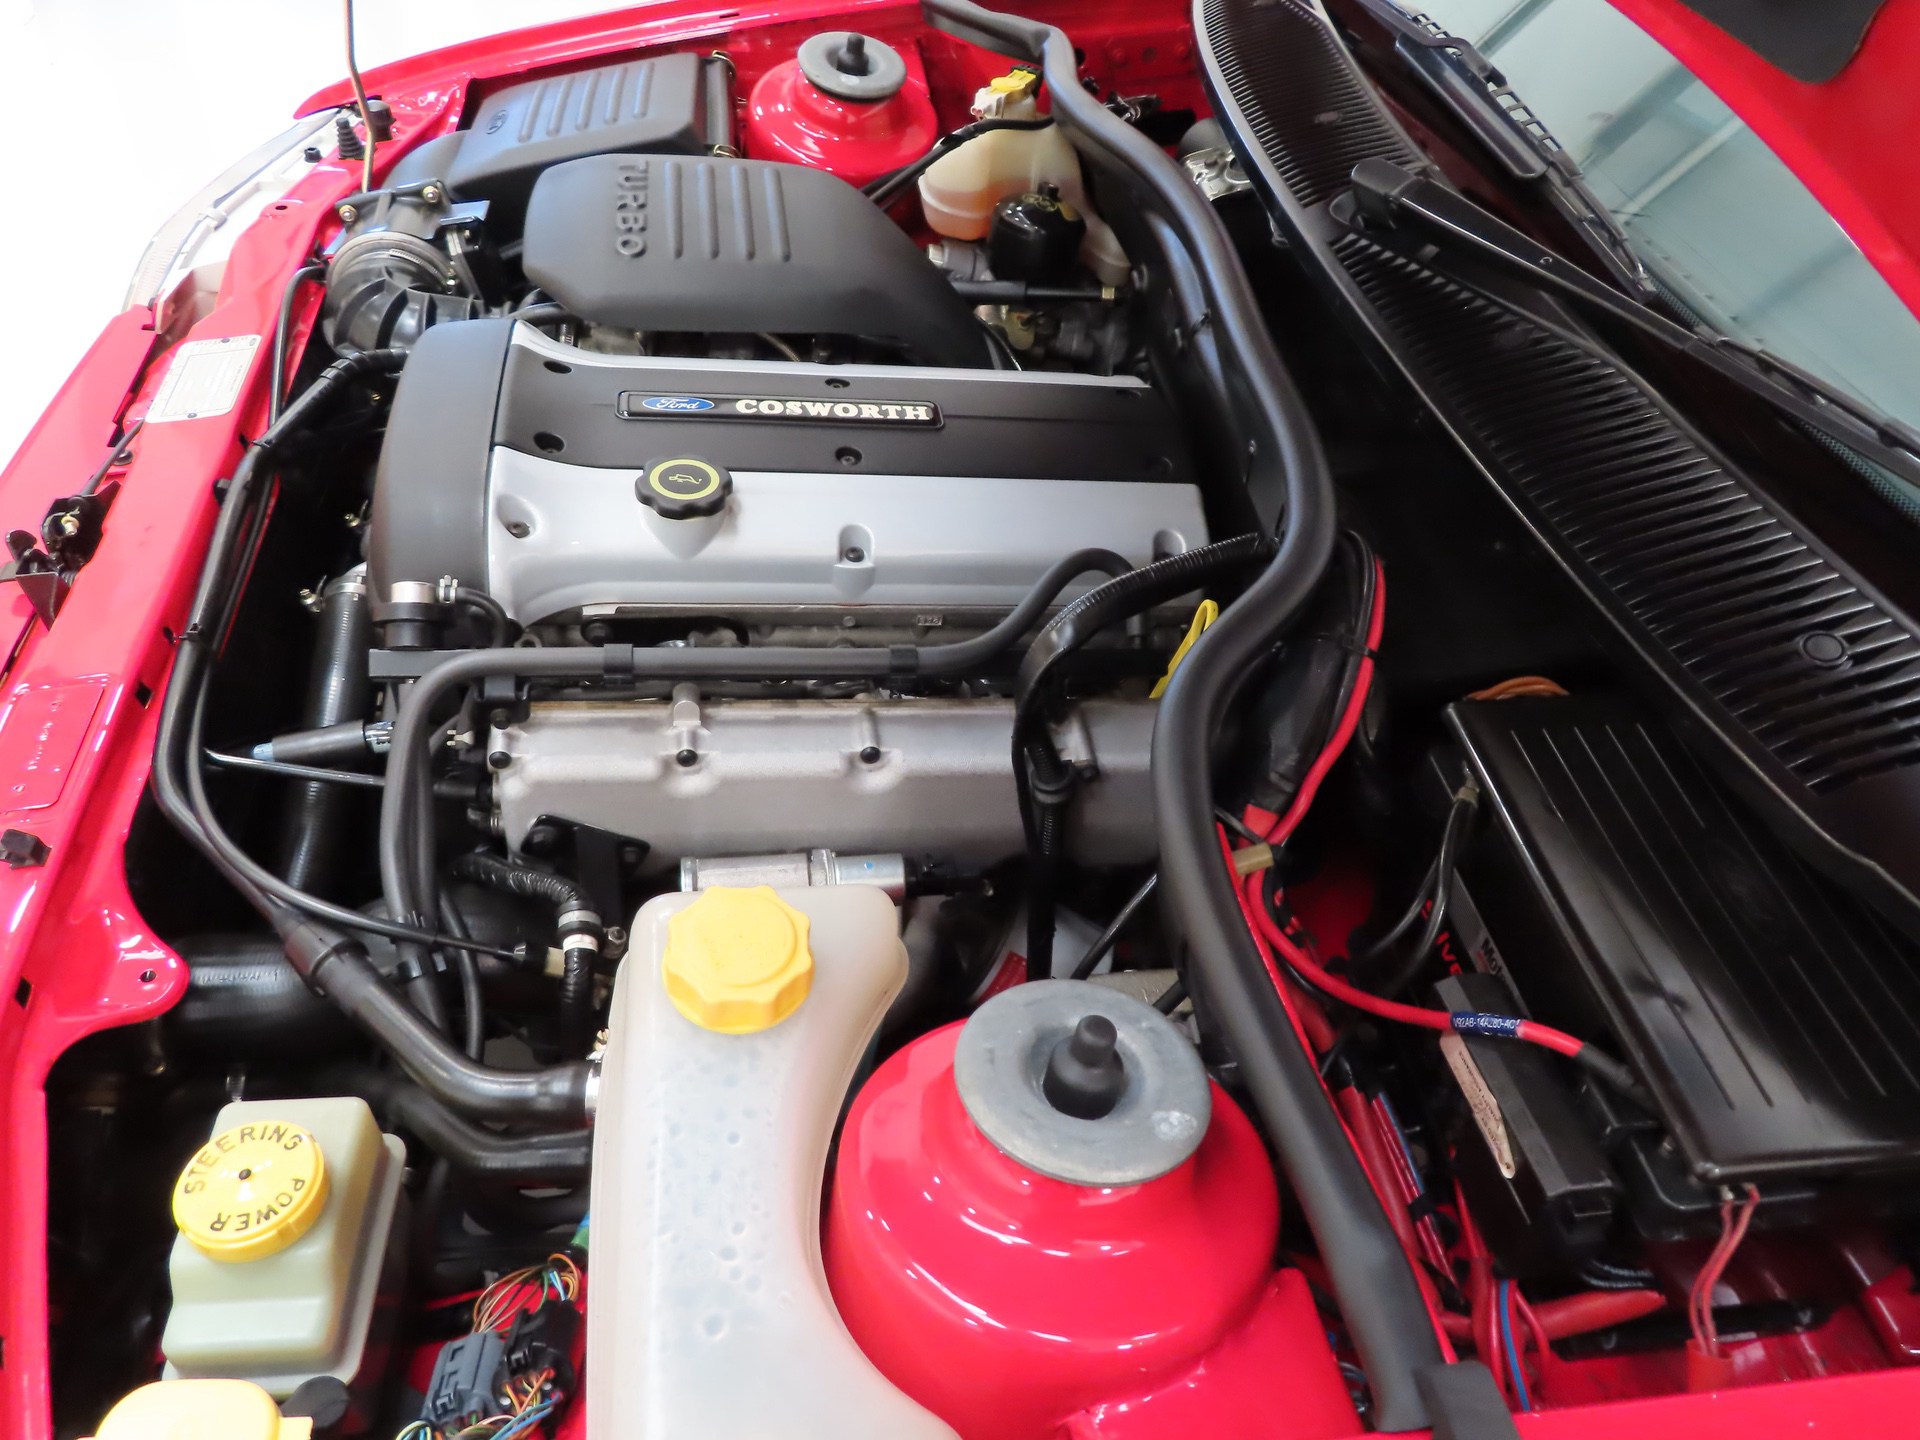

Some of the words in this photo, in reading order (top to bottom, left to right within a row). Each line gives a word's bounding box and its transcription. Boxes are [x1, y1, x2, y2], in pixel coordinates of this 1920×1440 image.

[616, 160, 648, 258] TURBO
[735, 399, 931, 421] COSWORTH
[184, 1125, 304, 1196] STEERING
[210, 1178, 306, 1232] POWER
